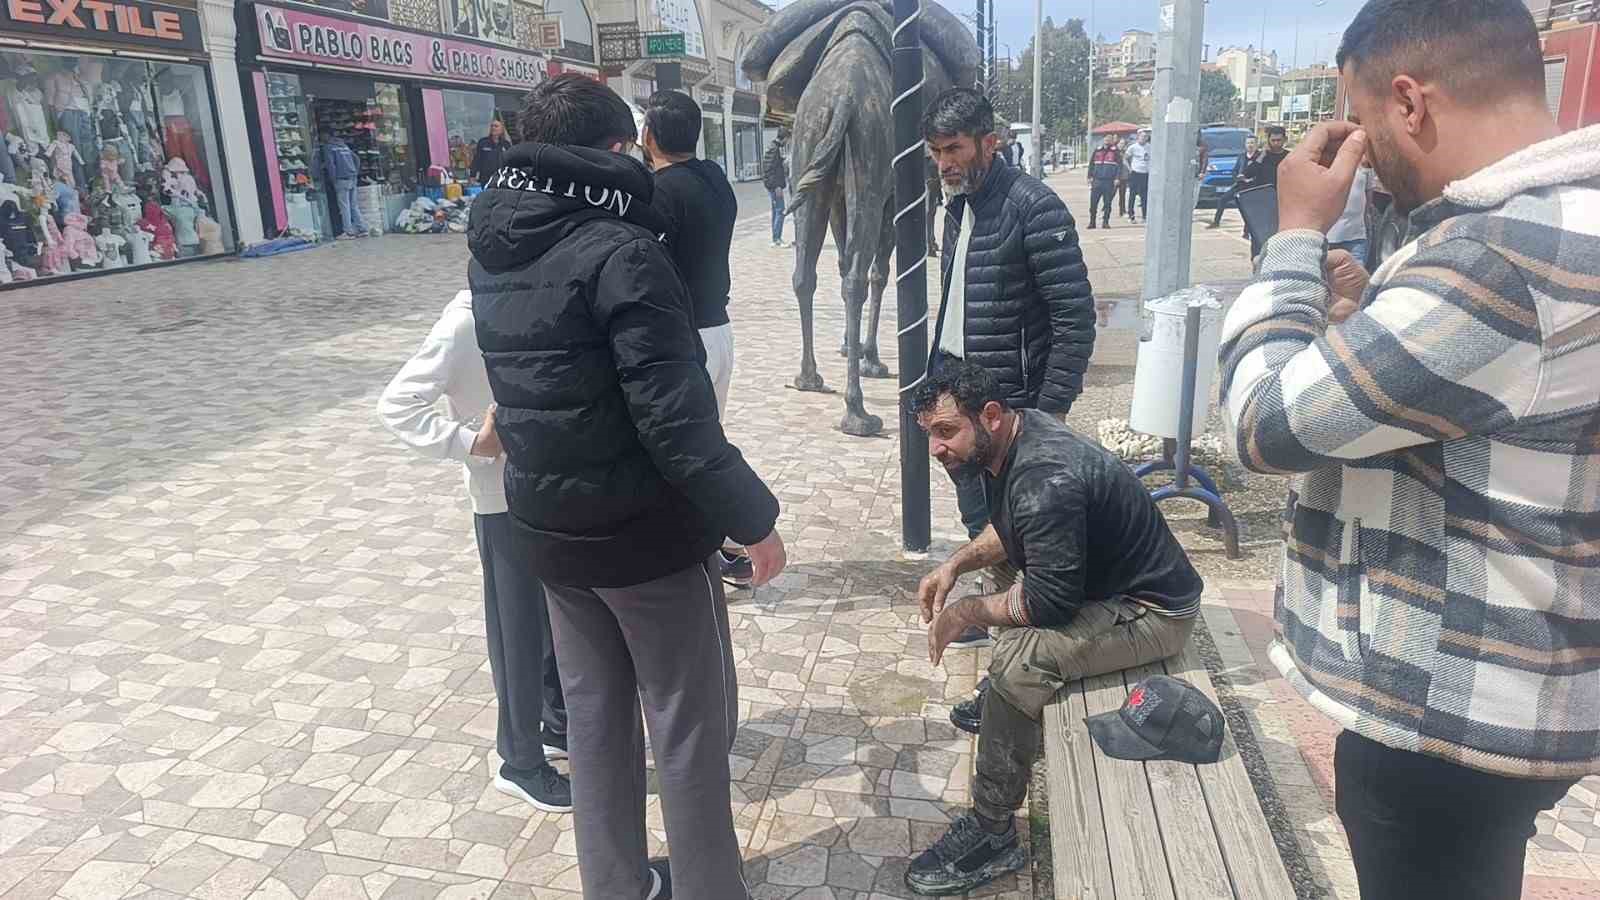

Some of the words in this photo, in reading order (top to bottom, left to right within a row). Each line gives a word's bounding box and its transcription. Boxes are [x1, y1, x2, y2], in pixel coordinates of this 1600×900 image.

[297, 22, 364, 60] PABLO
[369, 35, 414, 66] BAGS
[432, 41, 447, 72] &
[452, 51, 495, 76] PABLO
[500, 58, 535, 81] SHOES
